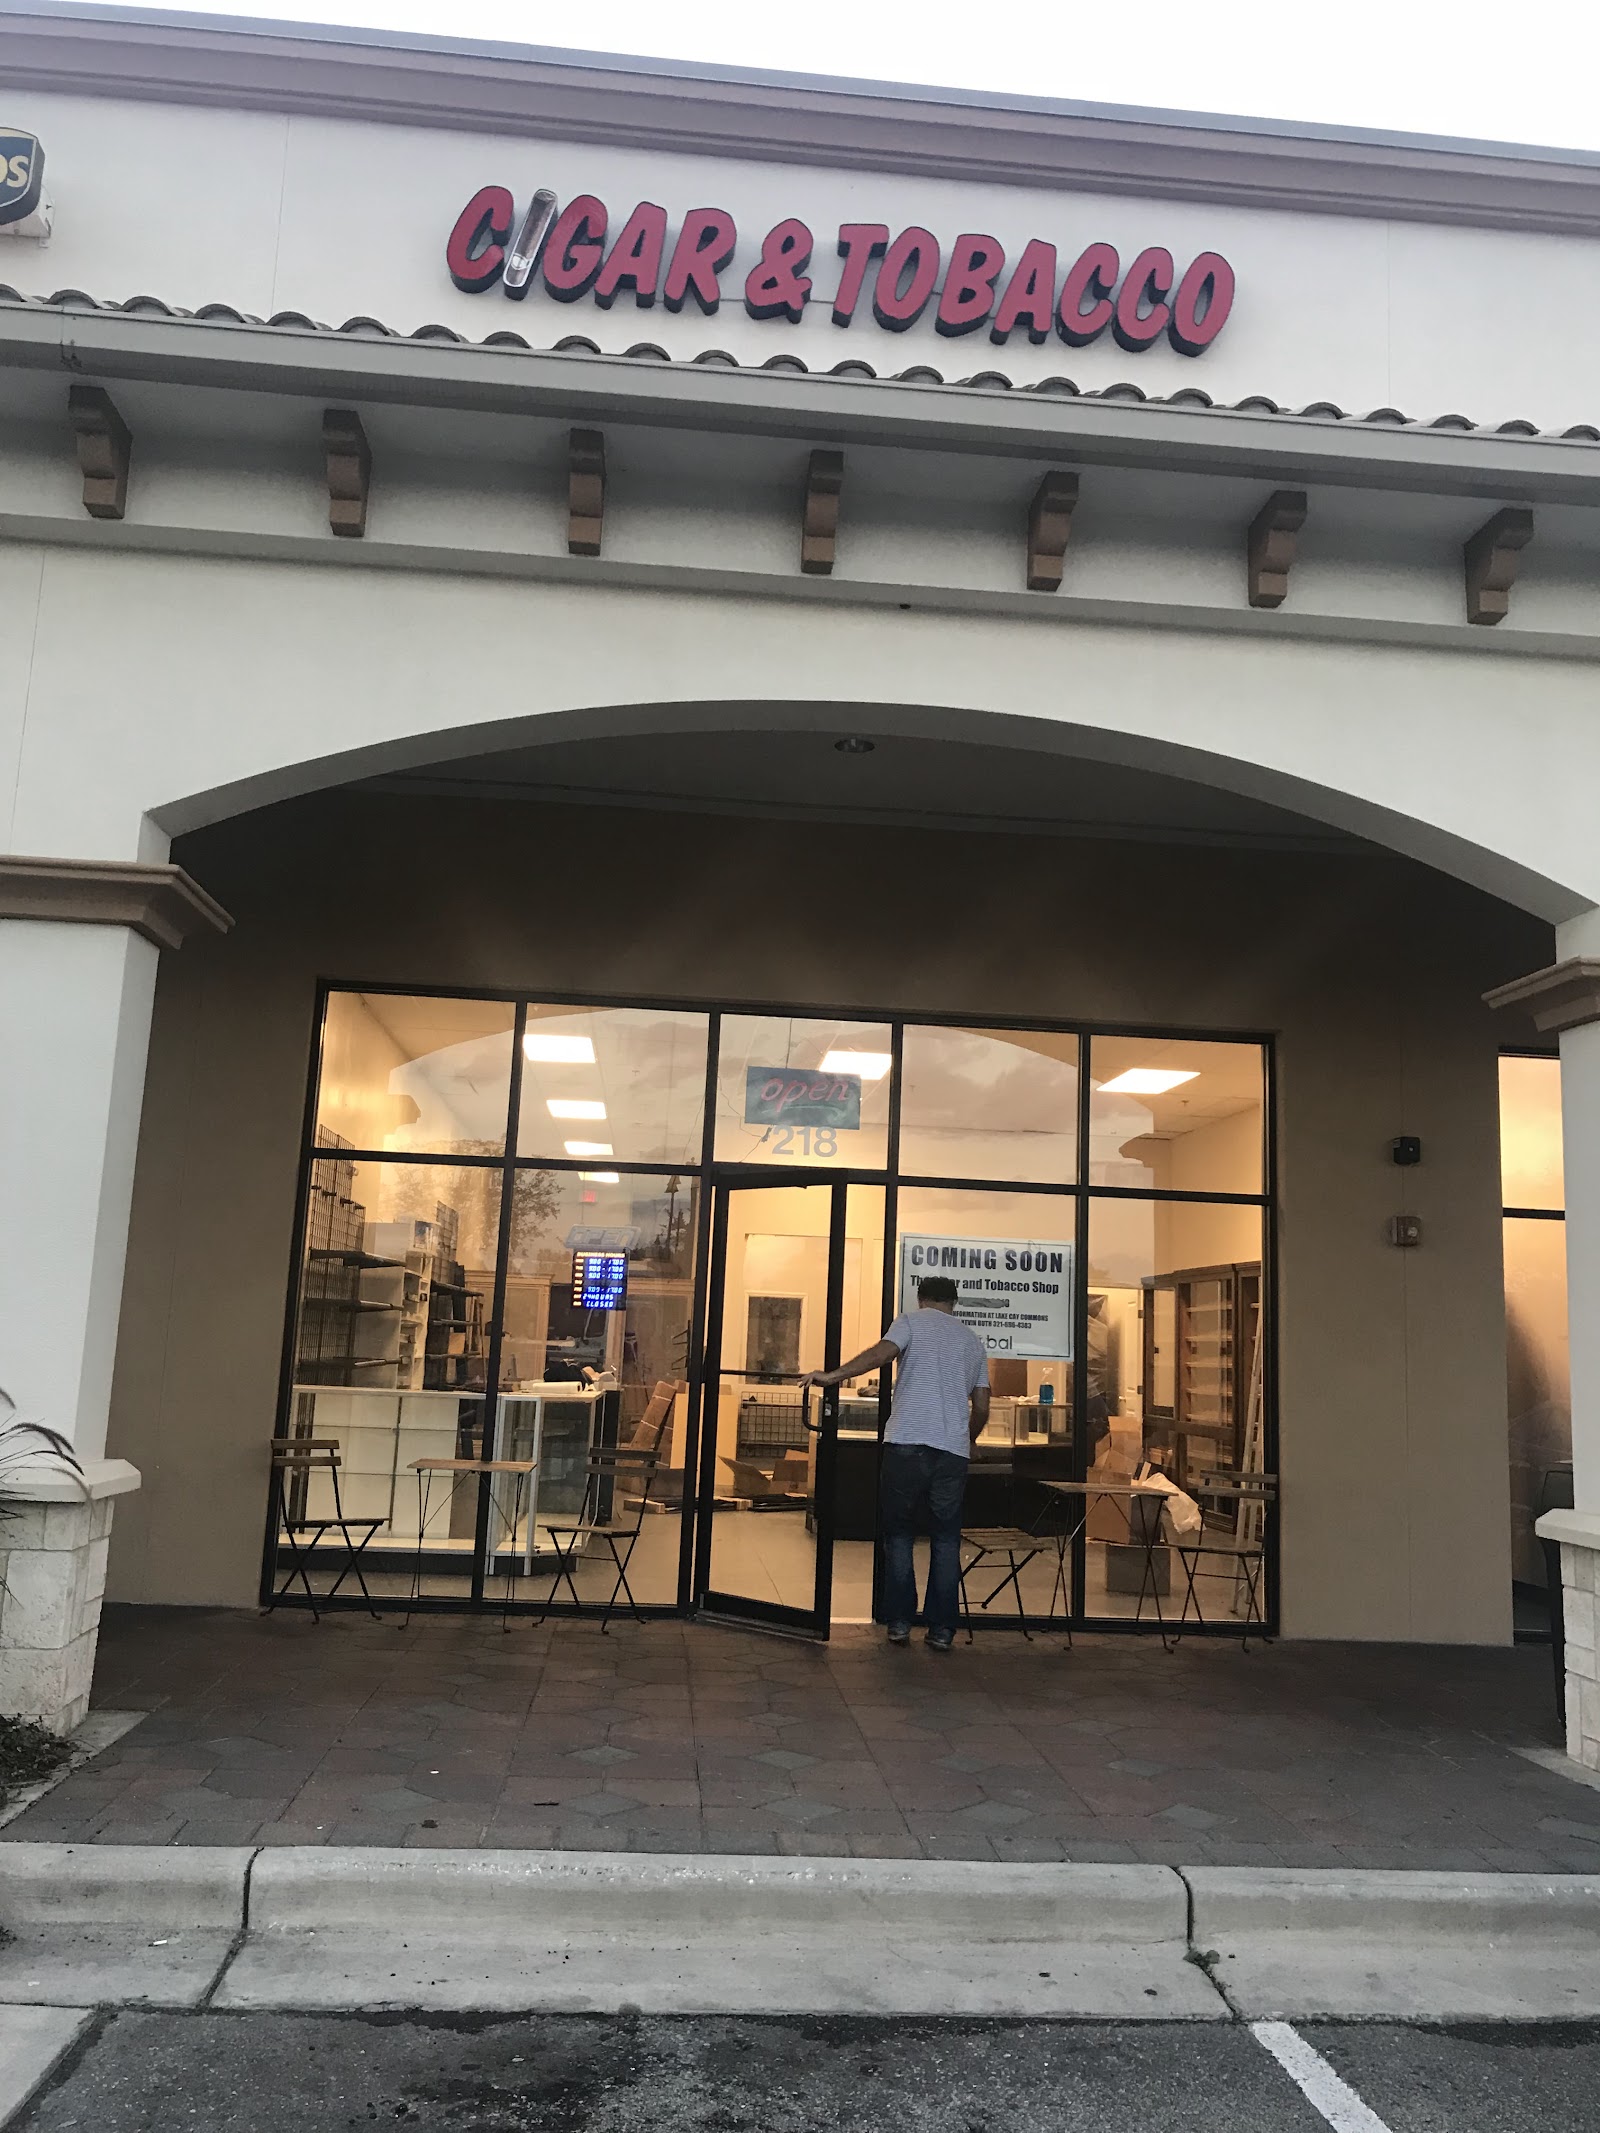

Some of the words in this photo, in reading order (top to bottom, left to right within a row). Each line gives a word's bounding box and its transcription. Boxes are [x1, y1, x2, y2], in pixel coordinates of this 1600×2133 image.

[446, 184, 738, 316] CIGAR
[744, 217, 815, 324] &
[832, 221, 1236, 358] TOBACCO
[760, 1077, 849, 1114] open
[772, 1124, 838, 1158] 218
[911, 1245, 997, 1270] COMING
[1005, 1250, 1063, 1273] SOON
[962, 1279, 983, 1290] and
[985, 1279, 1030, 1292] Tobacco
[1032, 1281, 1060, 1294] Shop
[952, 1310, 986, 1319] NFORMATION
[1020, 1313, 1049, 1322] COMMONS
